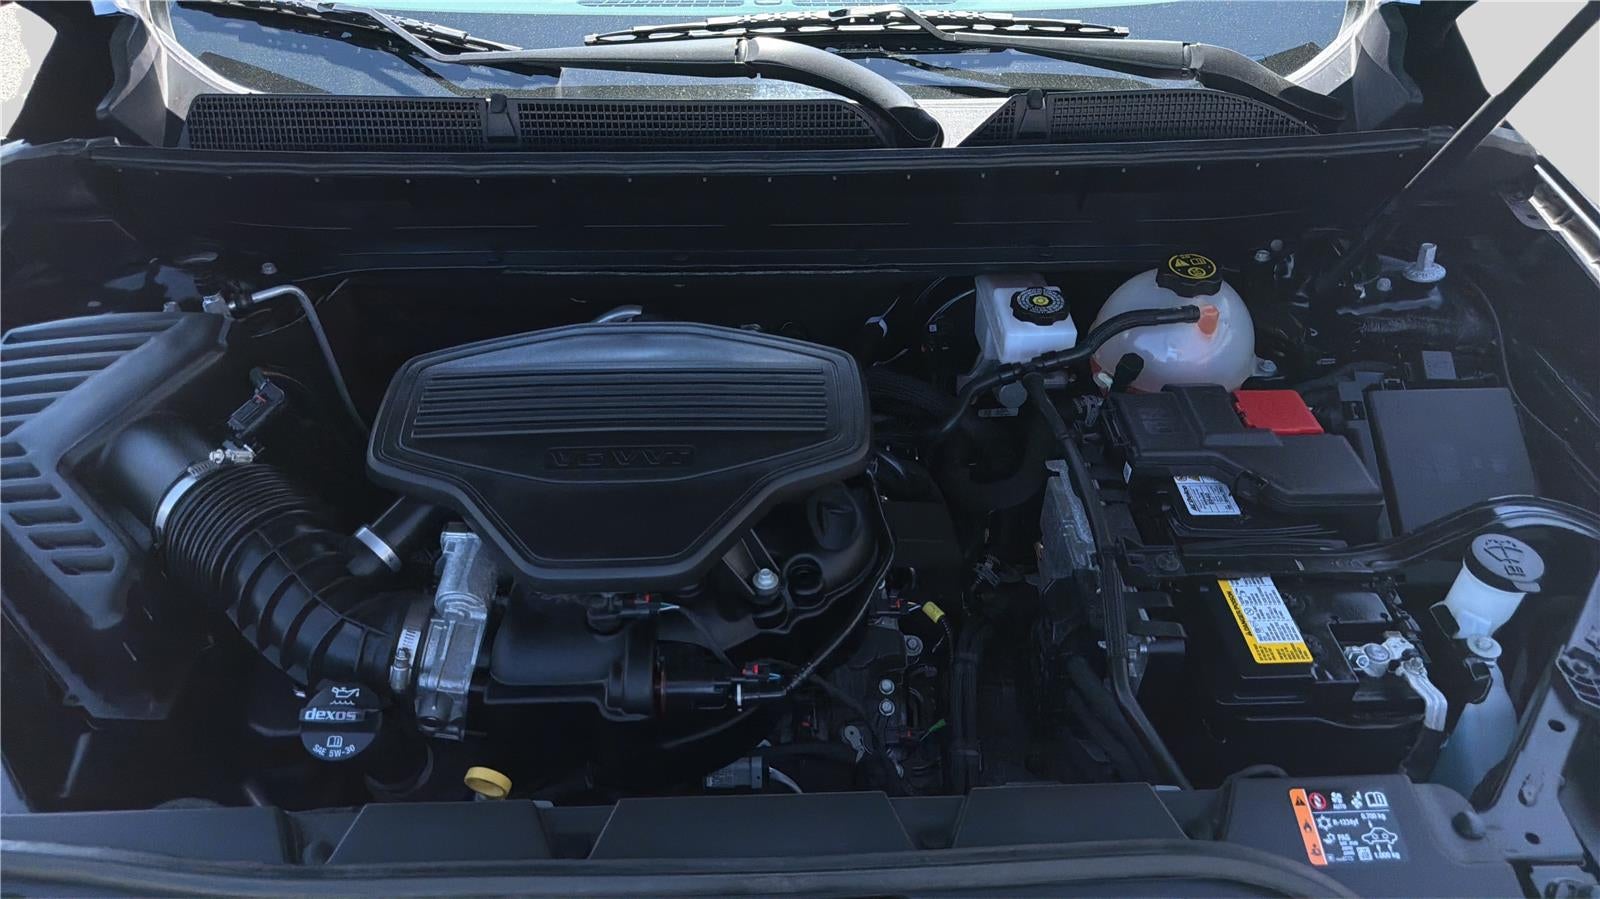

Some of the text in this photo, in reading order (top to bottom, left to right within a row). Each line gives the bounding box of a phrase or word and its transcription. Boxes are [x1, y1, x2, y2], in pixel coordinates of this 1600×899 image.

[304, 707, 358, 721] dexos
[312, 743, 356, 758] SAE 5W-30
